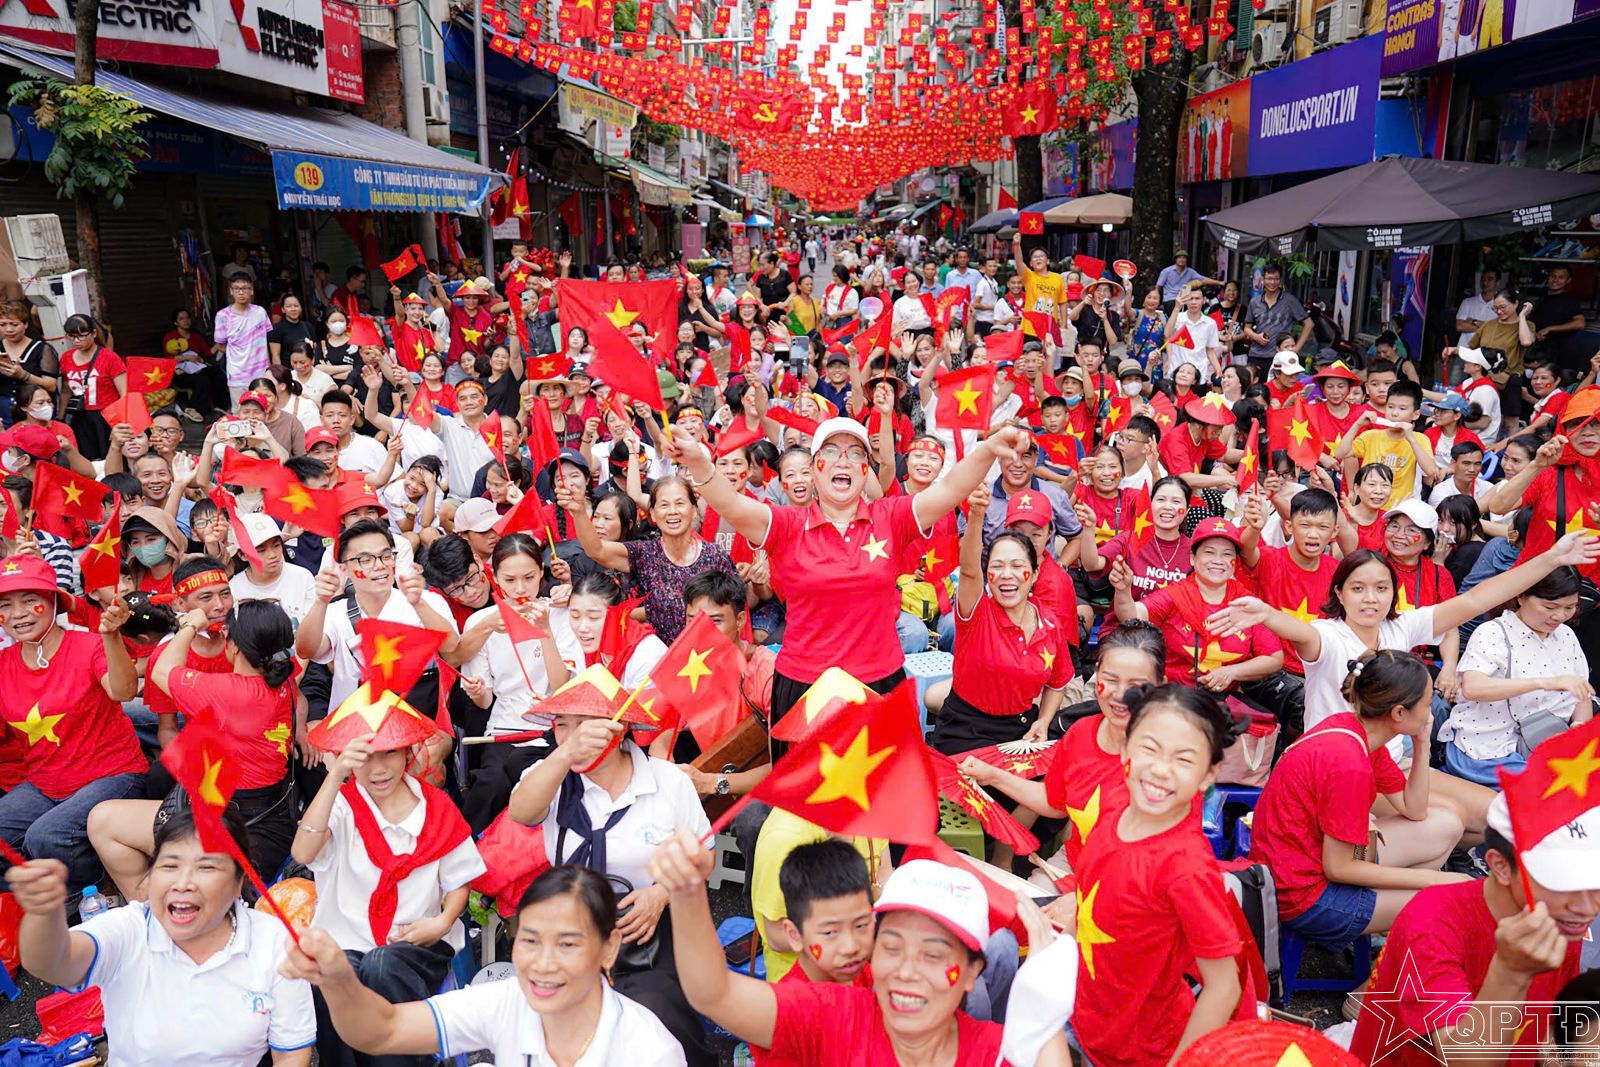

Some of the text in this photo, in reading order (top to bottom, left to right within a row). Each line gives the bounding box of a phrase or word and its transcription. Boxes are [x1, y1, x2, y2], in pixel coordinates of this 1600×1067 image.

[1387, 0, 1436, 33] CONTRAS
[1260, 85, 1359, 138] DONGLUCSPORT.VN
[301, 166, 319, 186] 139
[354, 165, 373, 184] CÔNG
[1133, 575, 1156, 591] VIỆT
